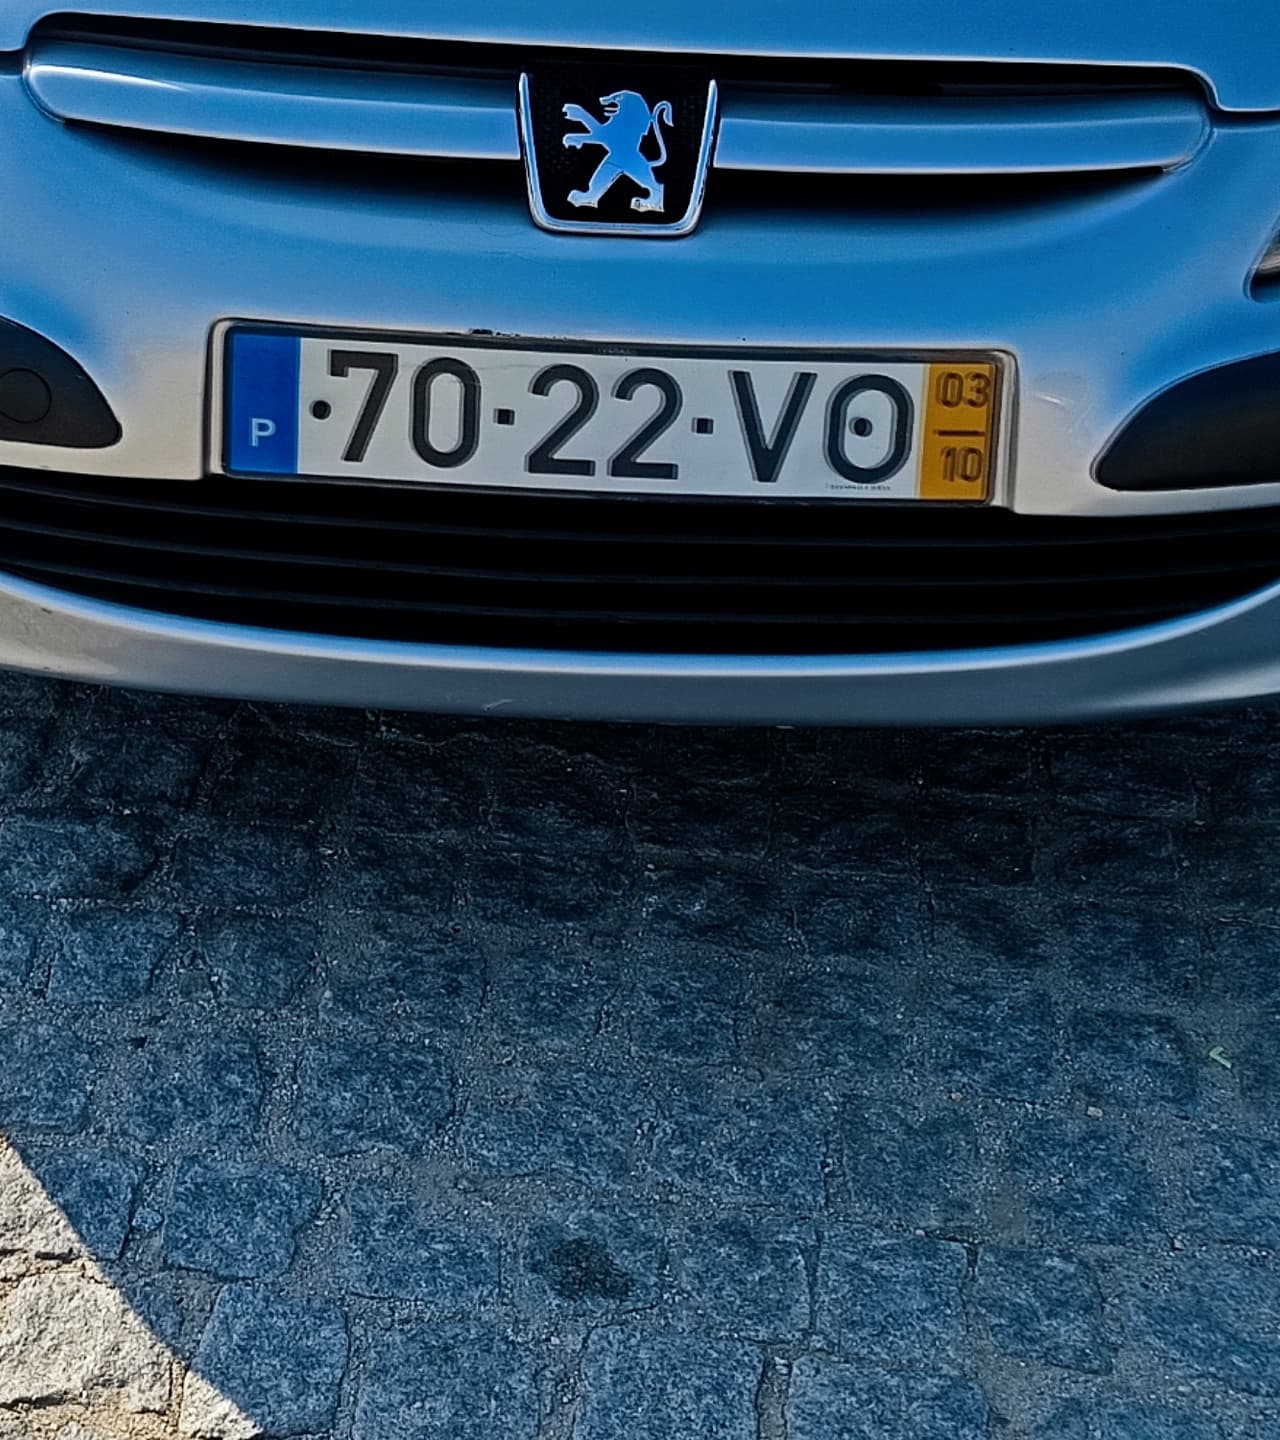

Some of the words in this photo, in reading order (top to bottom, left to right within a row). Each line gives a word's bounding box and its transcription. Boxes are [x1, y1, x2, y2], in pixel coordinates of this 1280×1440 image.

[936, 371, 991, 408] 03
[250, 417, 277, 447] P
[328, 348, 915, 484] 70·22·VO
[940, 446, 983, 482] 10
